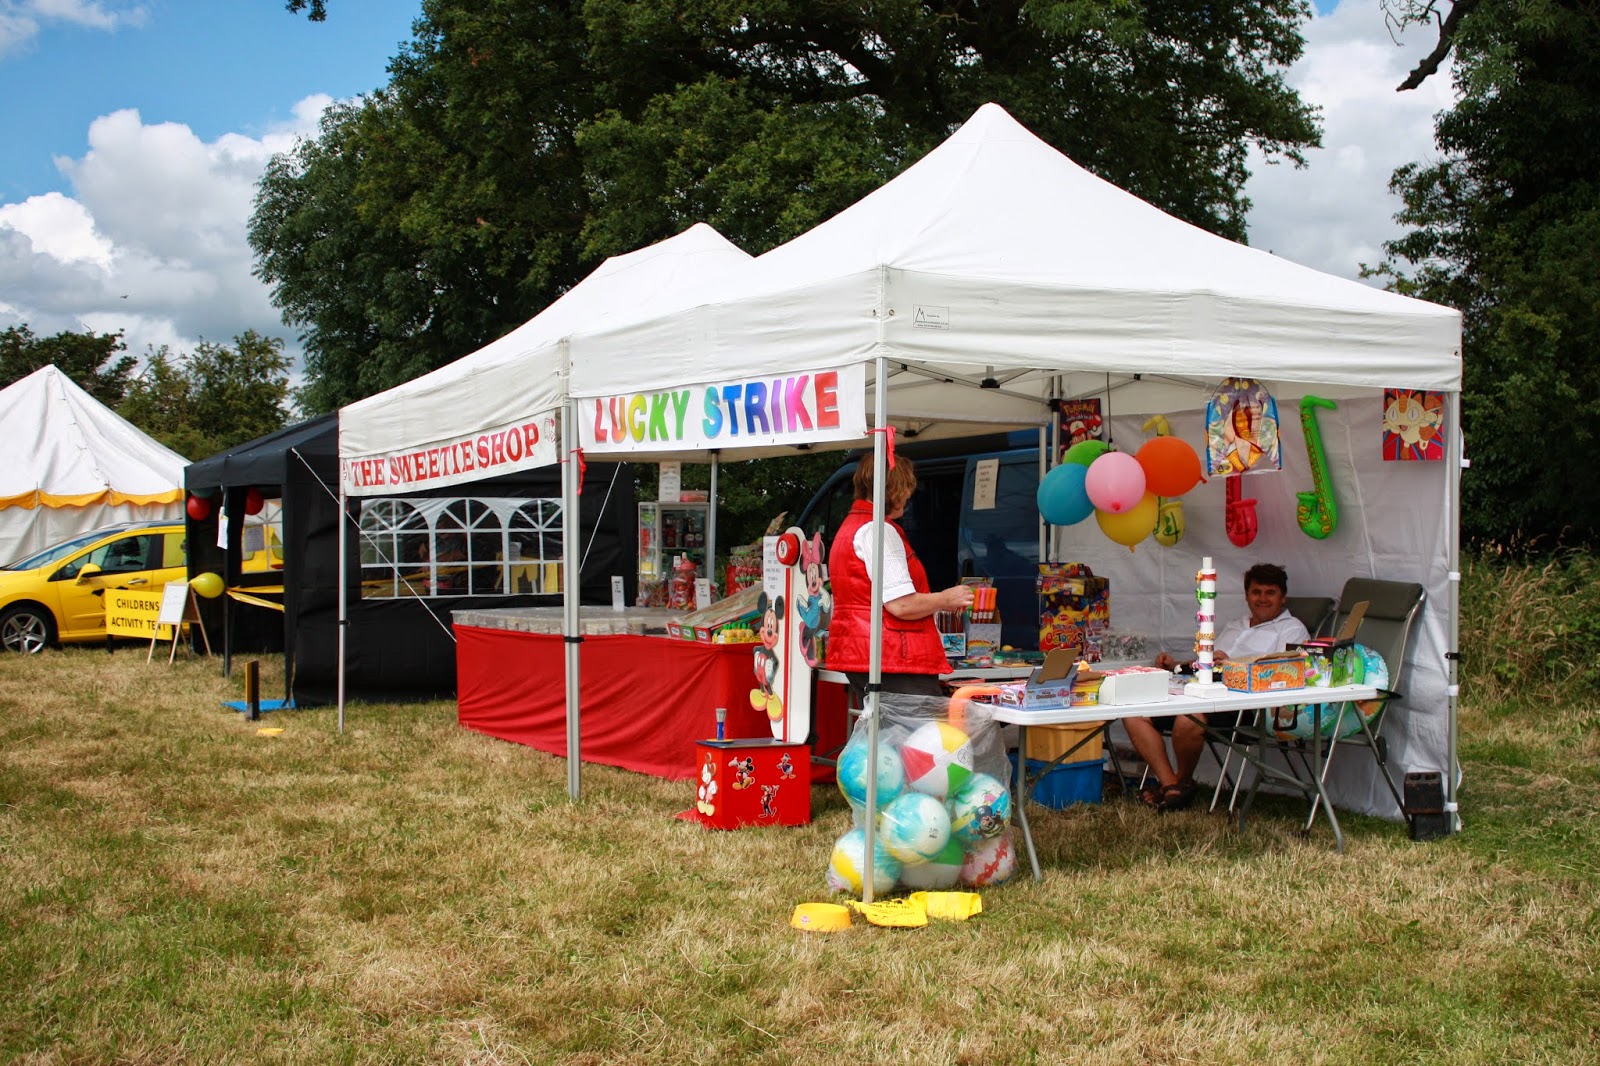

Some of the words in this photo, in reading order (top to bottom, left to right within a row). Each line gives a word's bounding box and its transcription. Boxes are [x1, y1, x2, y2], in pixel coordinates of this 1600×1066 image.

[595, 390, 691, 443] LUCKY
[702, 371, 840, 438] STRIKE
[351, 459, 385, 487] THE
[116, 598, 160, 611] CHILDRENS
[111, 617, 143, 629] ACTIVITY
